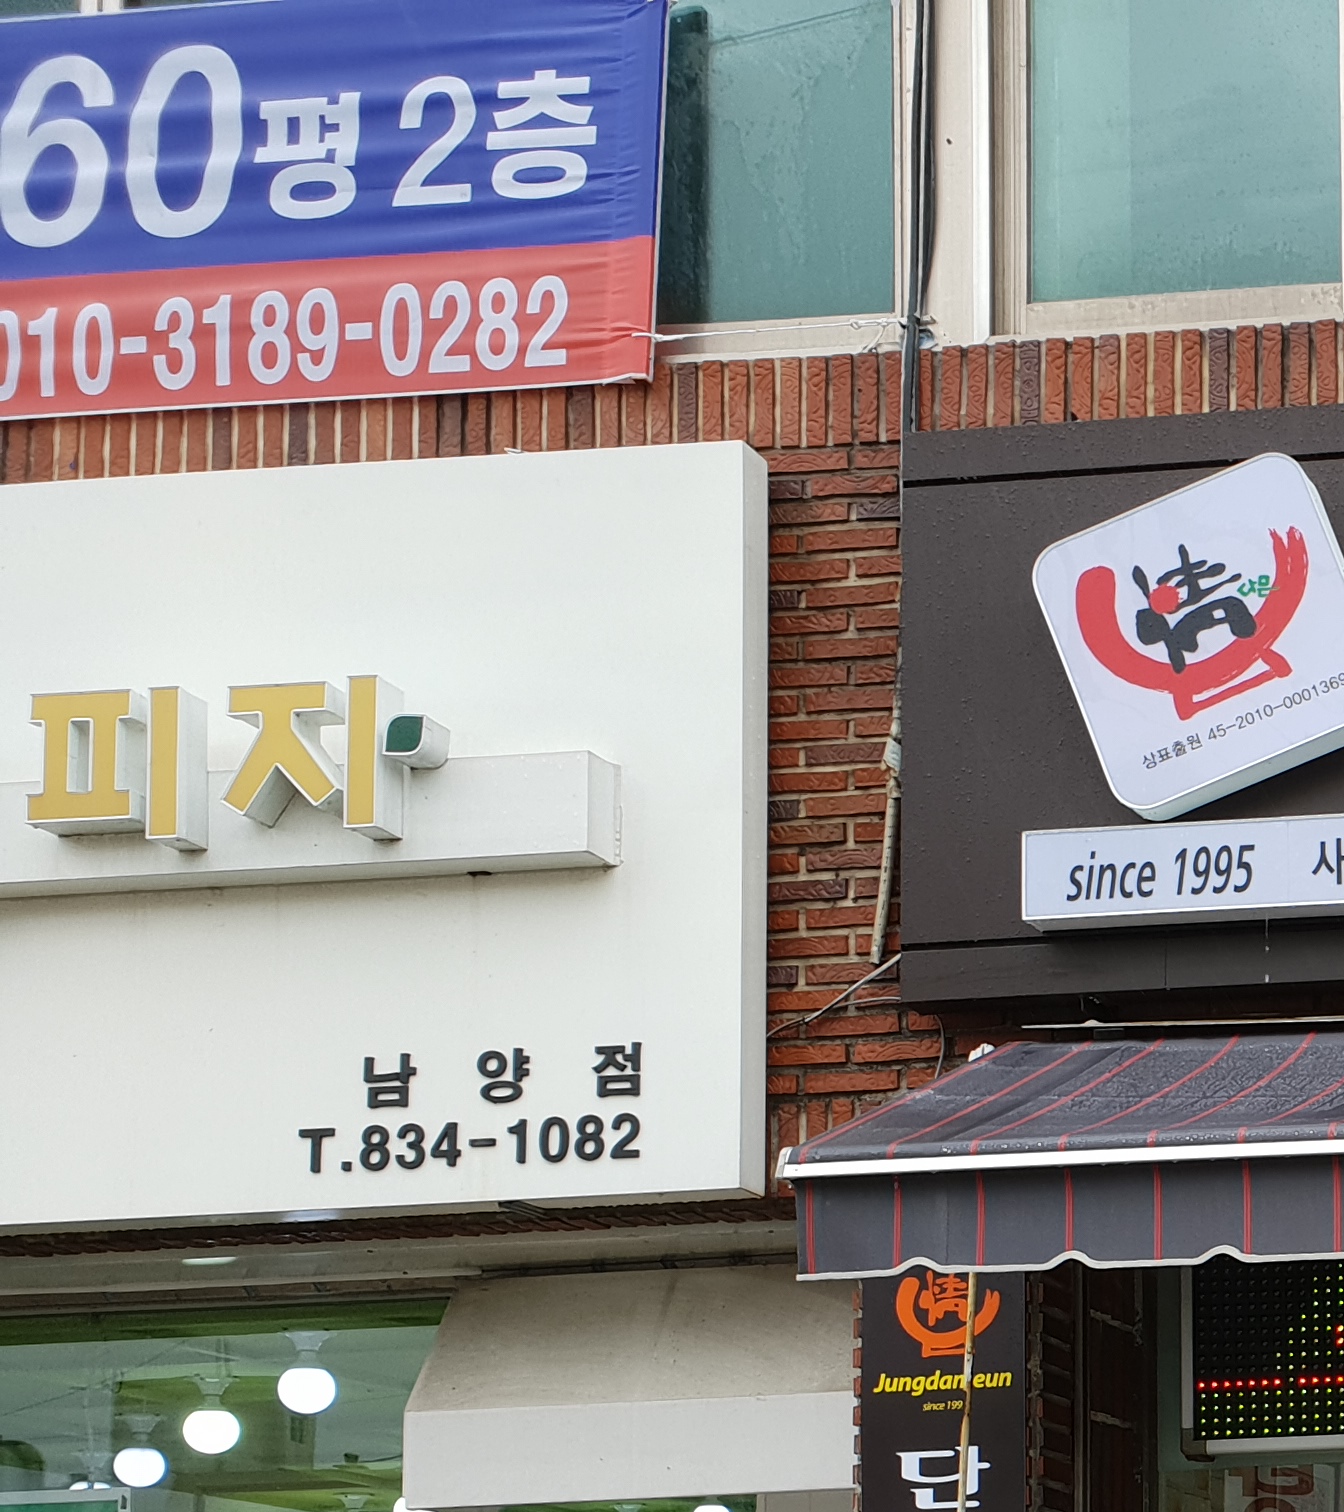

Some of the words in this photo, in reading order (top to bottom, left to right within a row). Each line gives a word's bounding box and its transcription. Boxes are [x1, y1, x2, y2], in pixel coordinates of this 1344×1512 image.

[0, 44, 362, 248] 60평
[391, 69, 597, 207] 2층
[26, 675, 382, 840] 피자
[1142, 733, 1203, 770] 상표출원
[1066, 850, 1156, 903] since
[1173, 844, 1254, 897] 1995
[299, 1112, 642, 1174] T.834-1082
[922, 1401, 946, 1412] since
[947, 1400, 965, 1411] 199
